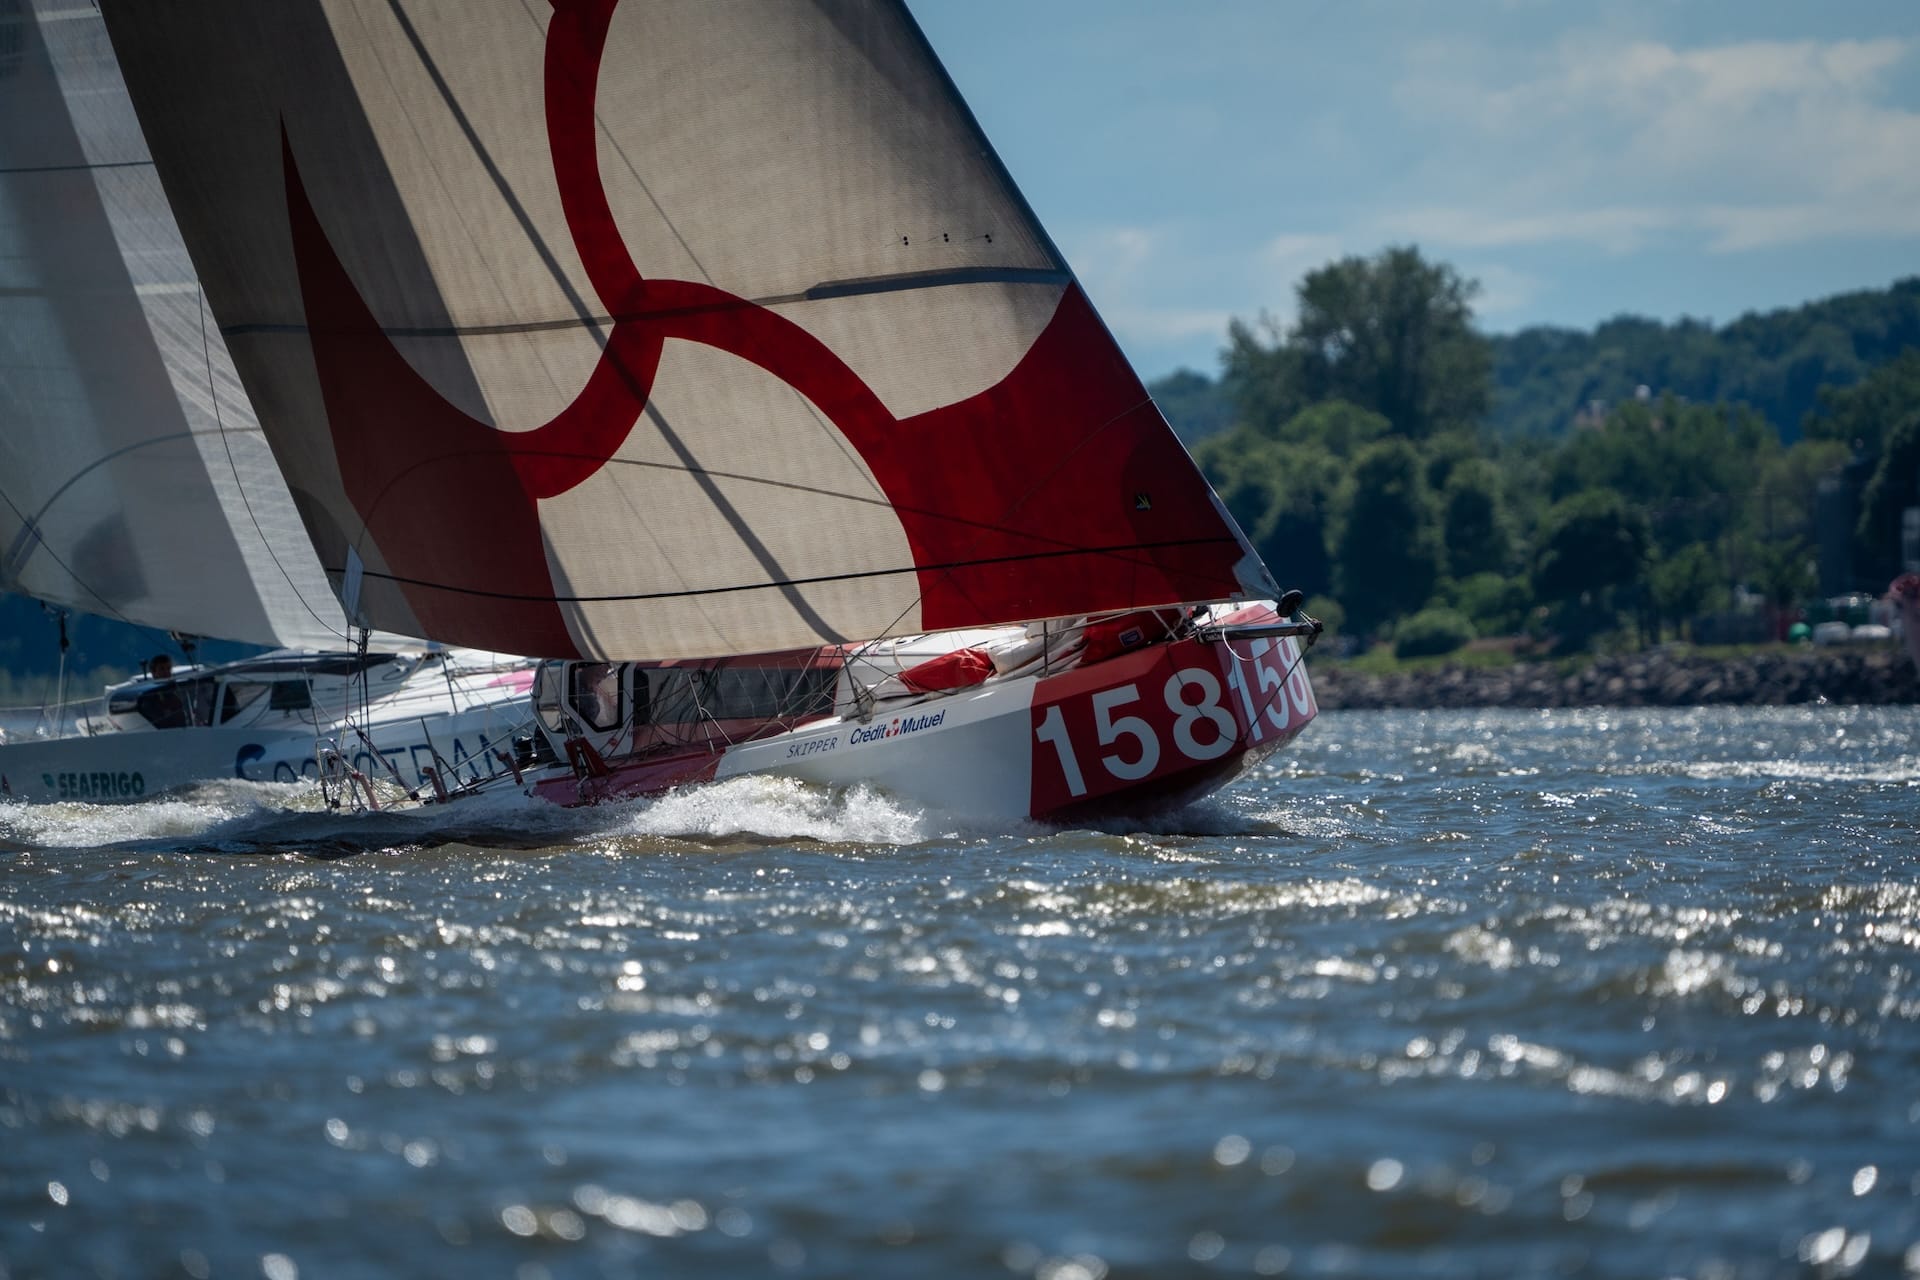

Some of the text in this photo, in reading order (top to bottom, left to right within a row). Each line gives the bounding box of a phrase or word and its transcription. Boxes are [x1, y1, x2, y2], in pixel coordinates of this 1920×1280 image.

[786, 709, 946, 759] SKIPPER Crédit Mutuel
[1035, 667, 1238, 798] 158
[58, 772, 145, 798] SEAFRIGO
